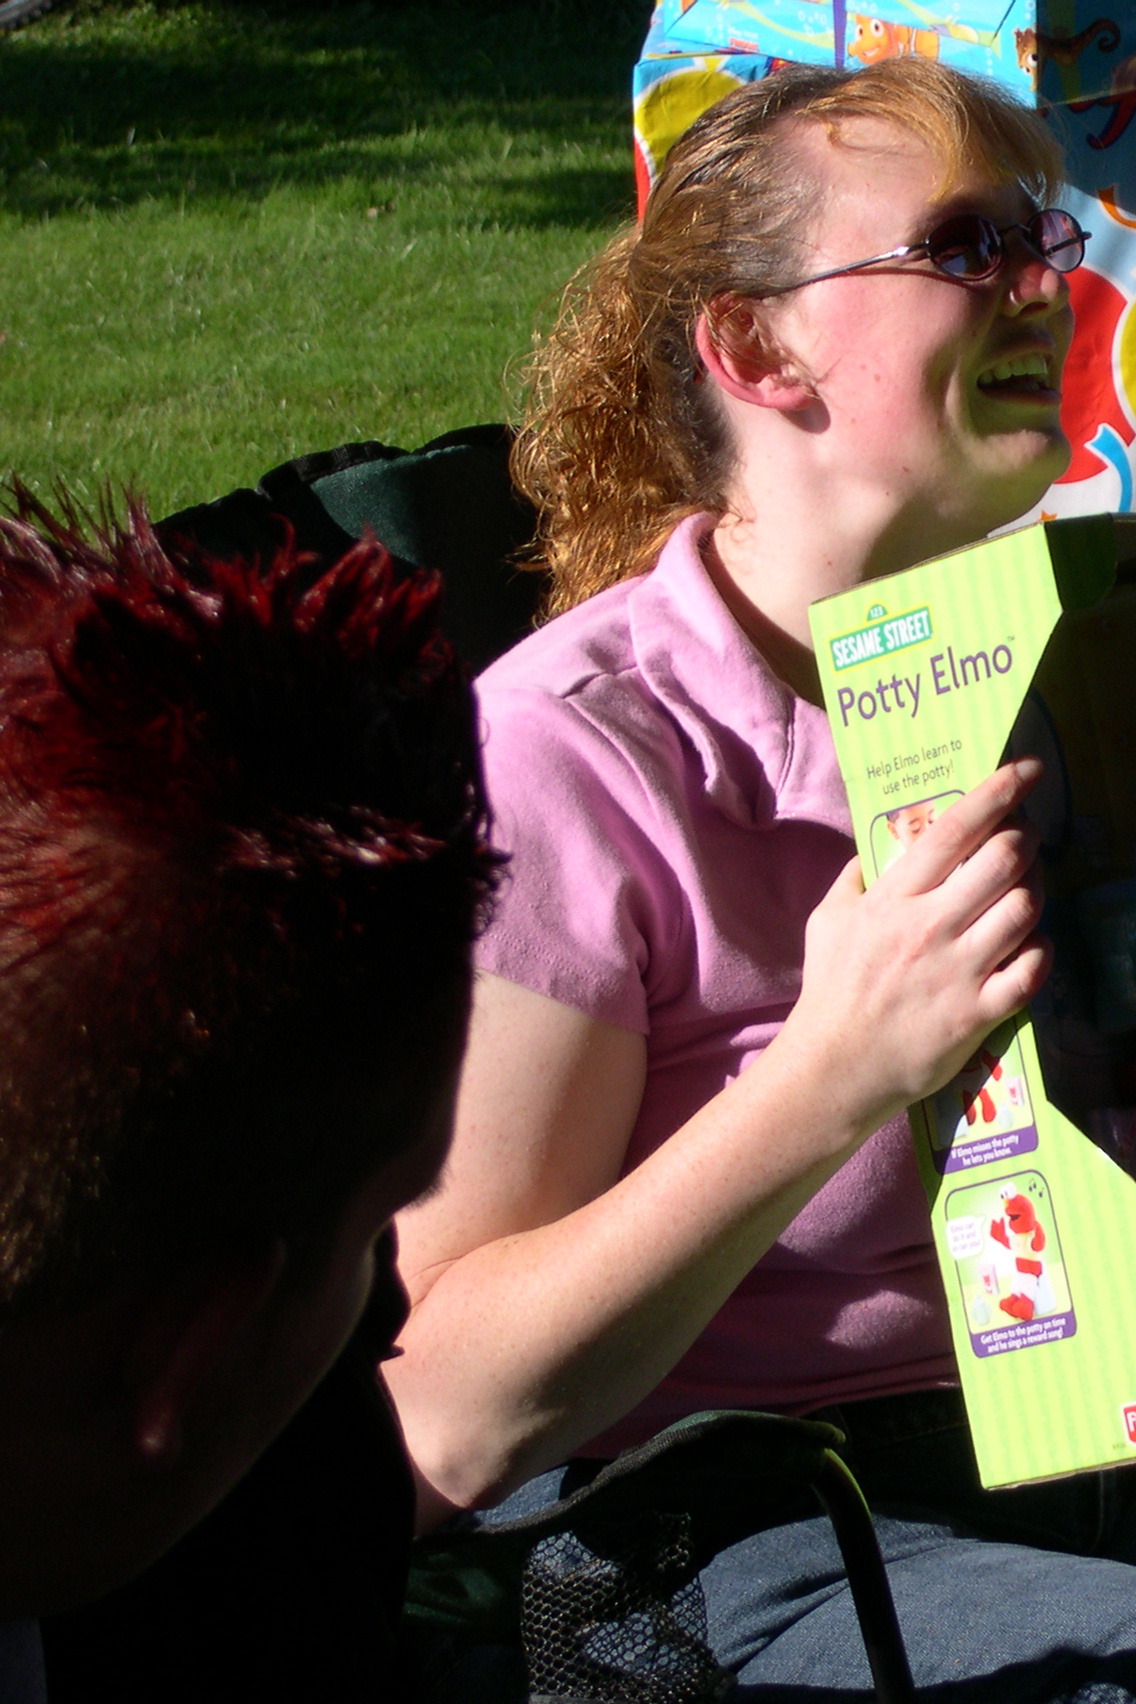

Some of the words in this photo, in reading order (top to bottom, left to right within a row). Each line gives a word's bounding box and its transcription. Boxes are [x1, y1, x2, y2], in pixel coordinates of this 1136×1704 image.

[870, 606, 884, 619] 123
[832, 624, 883, 667] SESAME
[884, 611, 931, 652] STREET
[837, 673, 921, 727] Potty
[930, 645, 1013, 695] Elmo
[866, 759, 892, 779] Help
[893, 753, 920, 772] Elmo
[921, 743, 949, 762] learn
[950, 739, 962, 752] to
[882, 779, 900, 795] use
[902, 772, 921, 787] the
[923, 760, 954, 785] potty!
[957, 1147, 972, 1157] Elmo
[991, 1138, 1002, 1148] the
[1002, 1135, 1019, 1147] potty
[962, 1157, 972, 1166] he
[983, 1152, 995, 1163] you
[980, 1334, 992, 1345] Get
[992, 1331, 1008, 1342] Elmo
[1008, 1330, 1015, 1338] to
[1015, 1326, 1026, 1336] the
[1026, 1323, 1043, 1335] potty
[1043, 1321, 1052, 1329] on
[1051, 1317, 1066, 1326] time
[988, 1342, 999, 1353] and
[999, 1341, 1007, 1350] he
